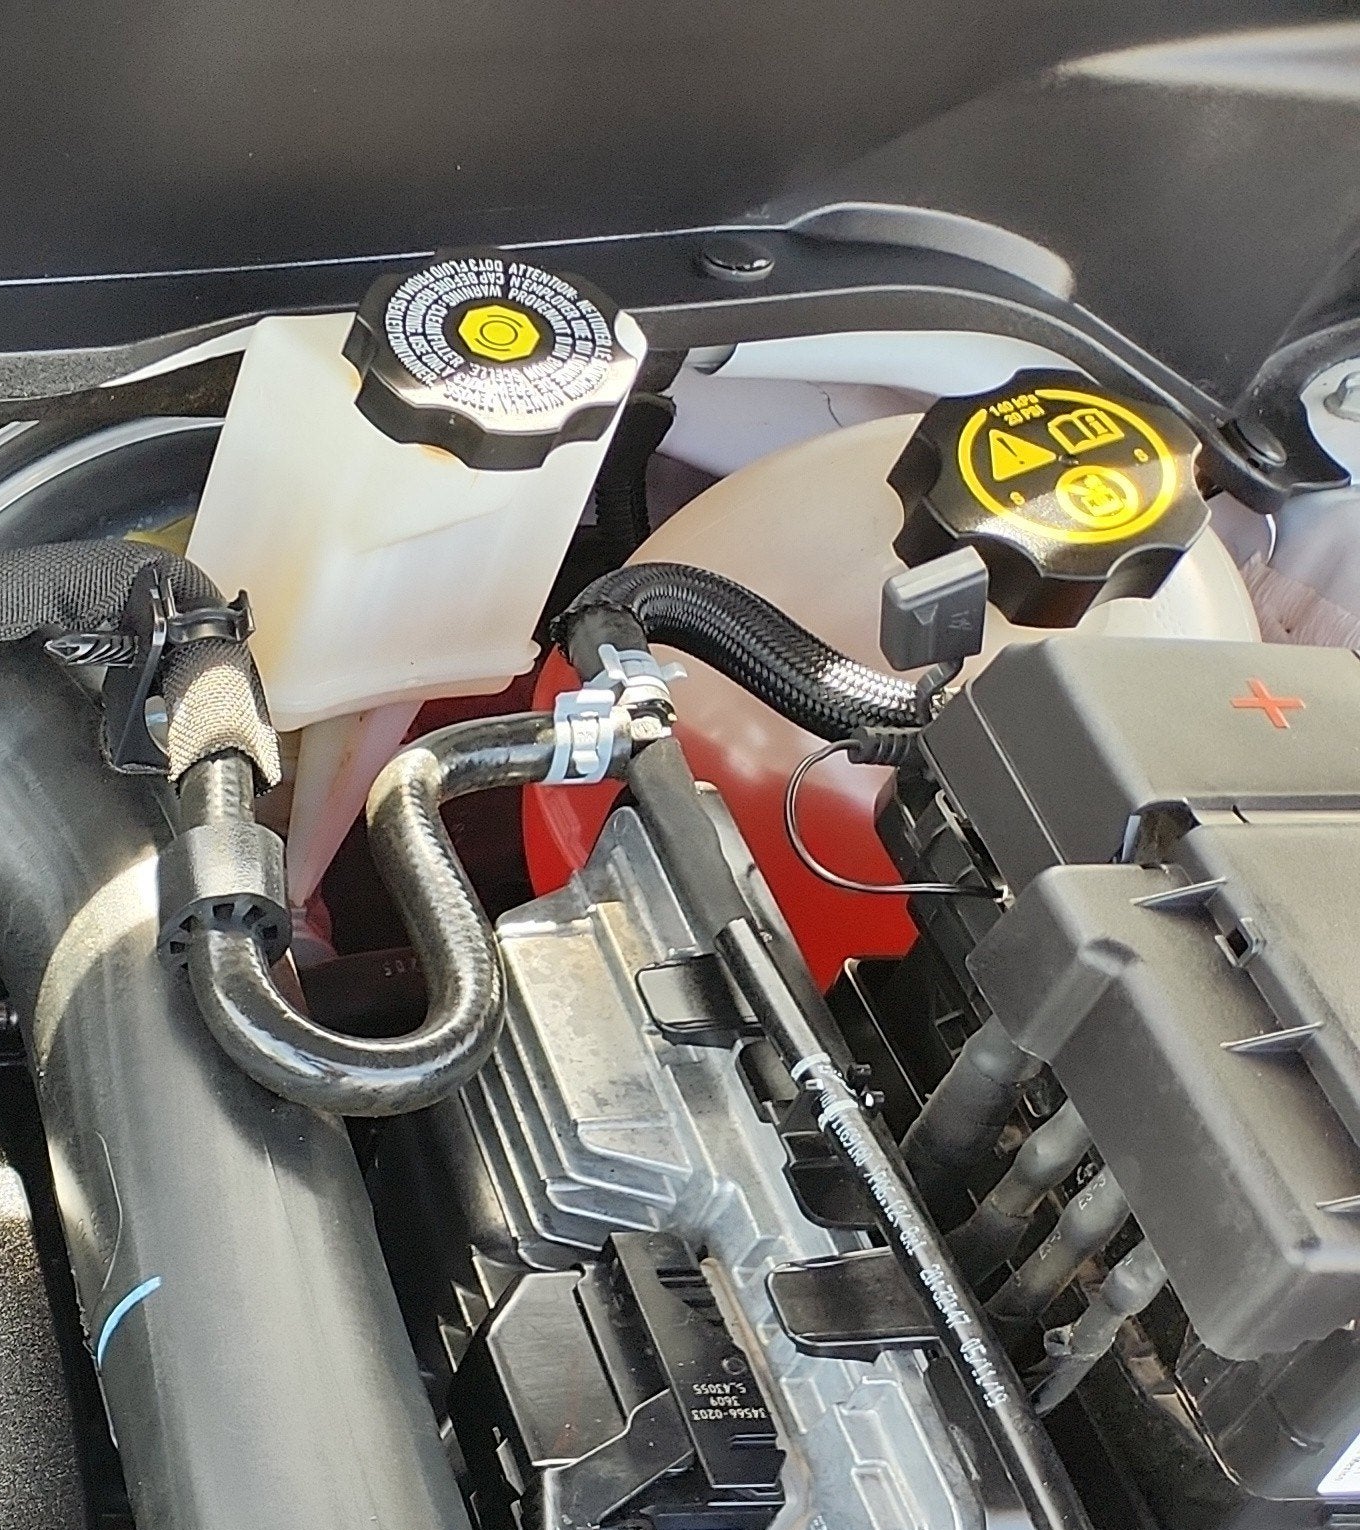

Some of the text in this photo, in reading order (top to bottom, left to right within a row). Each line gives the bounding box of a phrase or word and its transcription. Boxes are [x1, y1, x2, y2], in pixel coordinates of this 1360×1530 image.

[429, 259, 469, 278] FLUID
[480, 272, 504, 285] CAP
[400, 269, 435, 296] FROM
[429, 271, 478, 295] BEFORE
